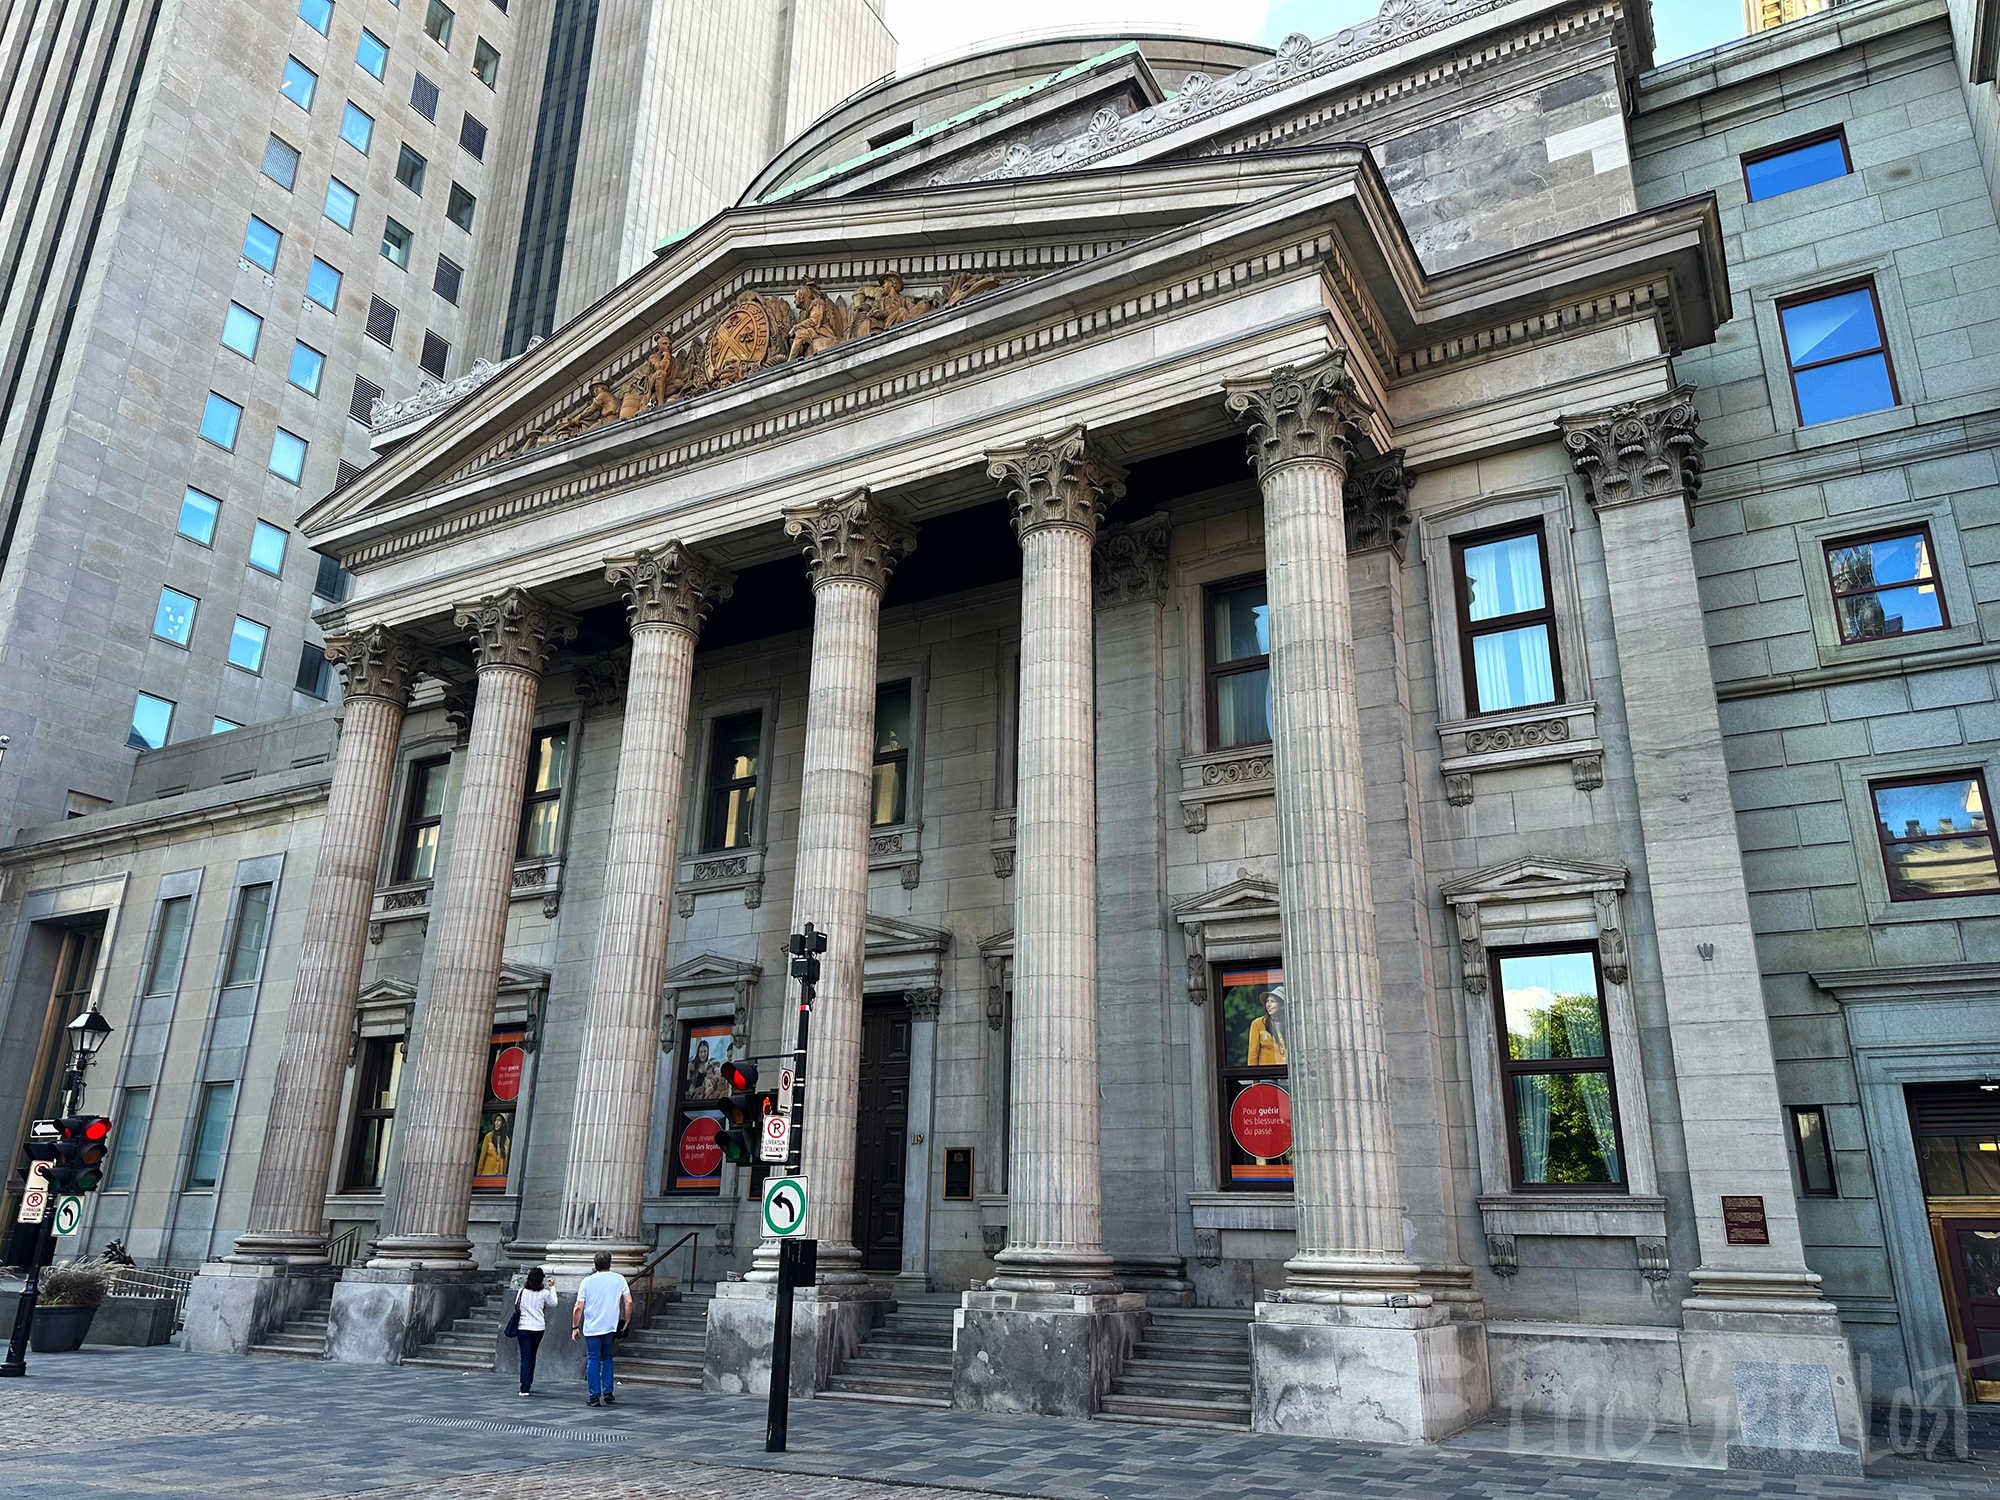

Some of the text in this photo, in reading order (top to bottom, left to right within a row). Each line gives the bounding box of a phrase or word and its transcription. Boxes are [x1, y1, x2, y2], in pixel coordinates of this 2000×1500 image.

[1242, 1106, 1279, 1116] Pour guérir
[1254, 1117, 1284, 1125] blessures
[1244, 1127, 1274, 1136] du passé.
[911, 1133, 924, 1145] 119
